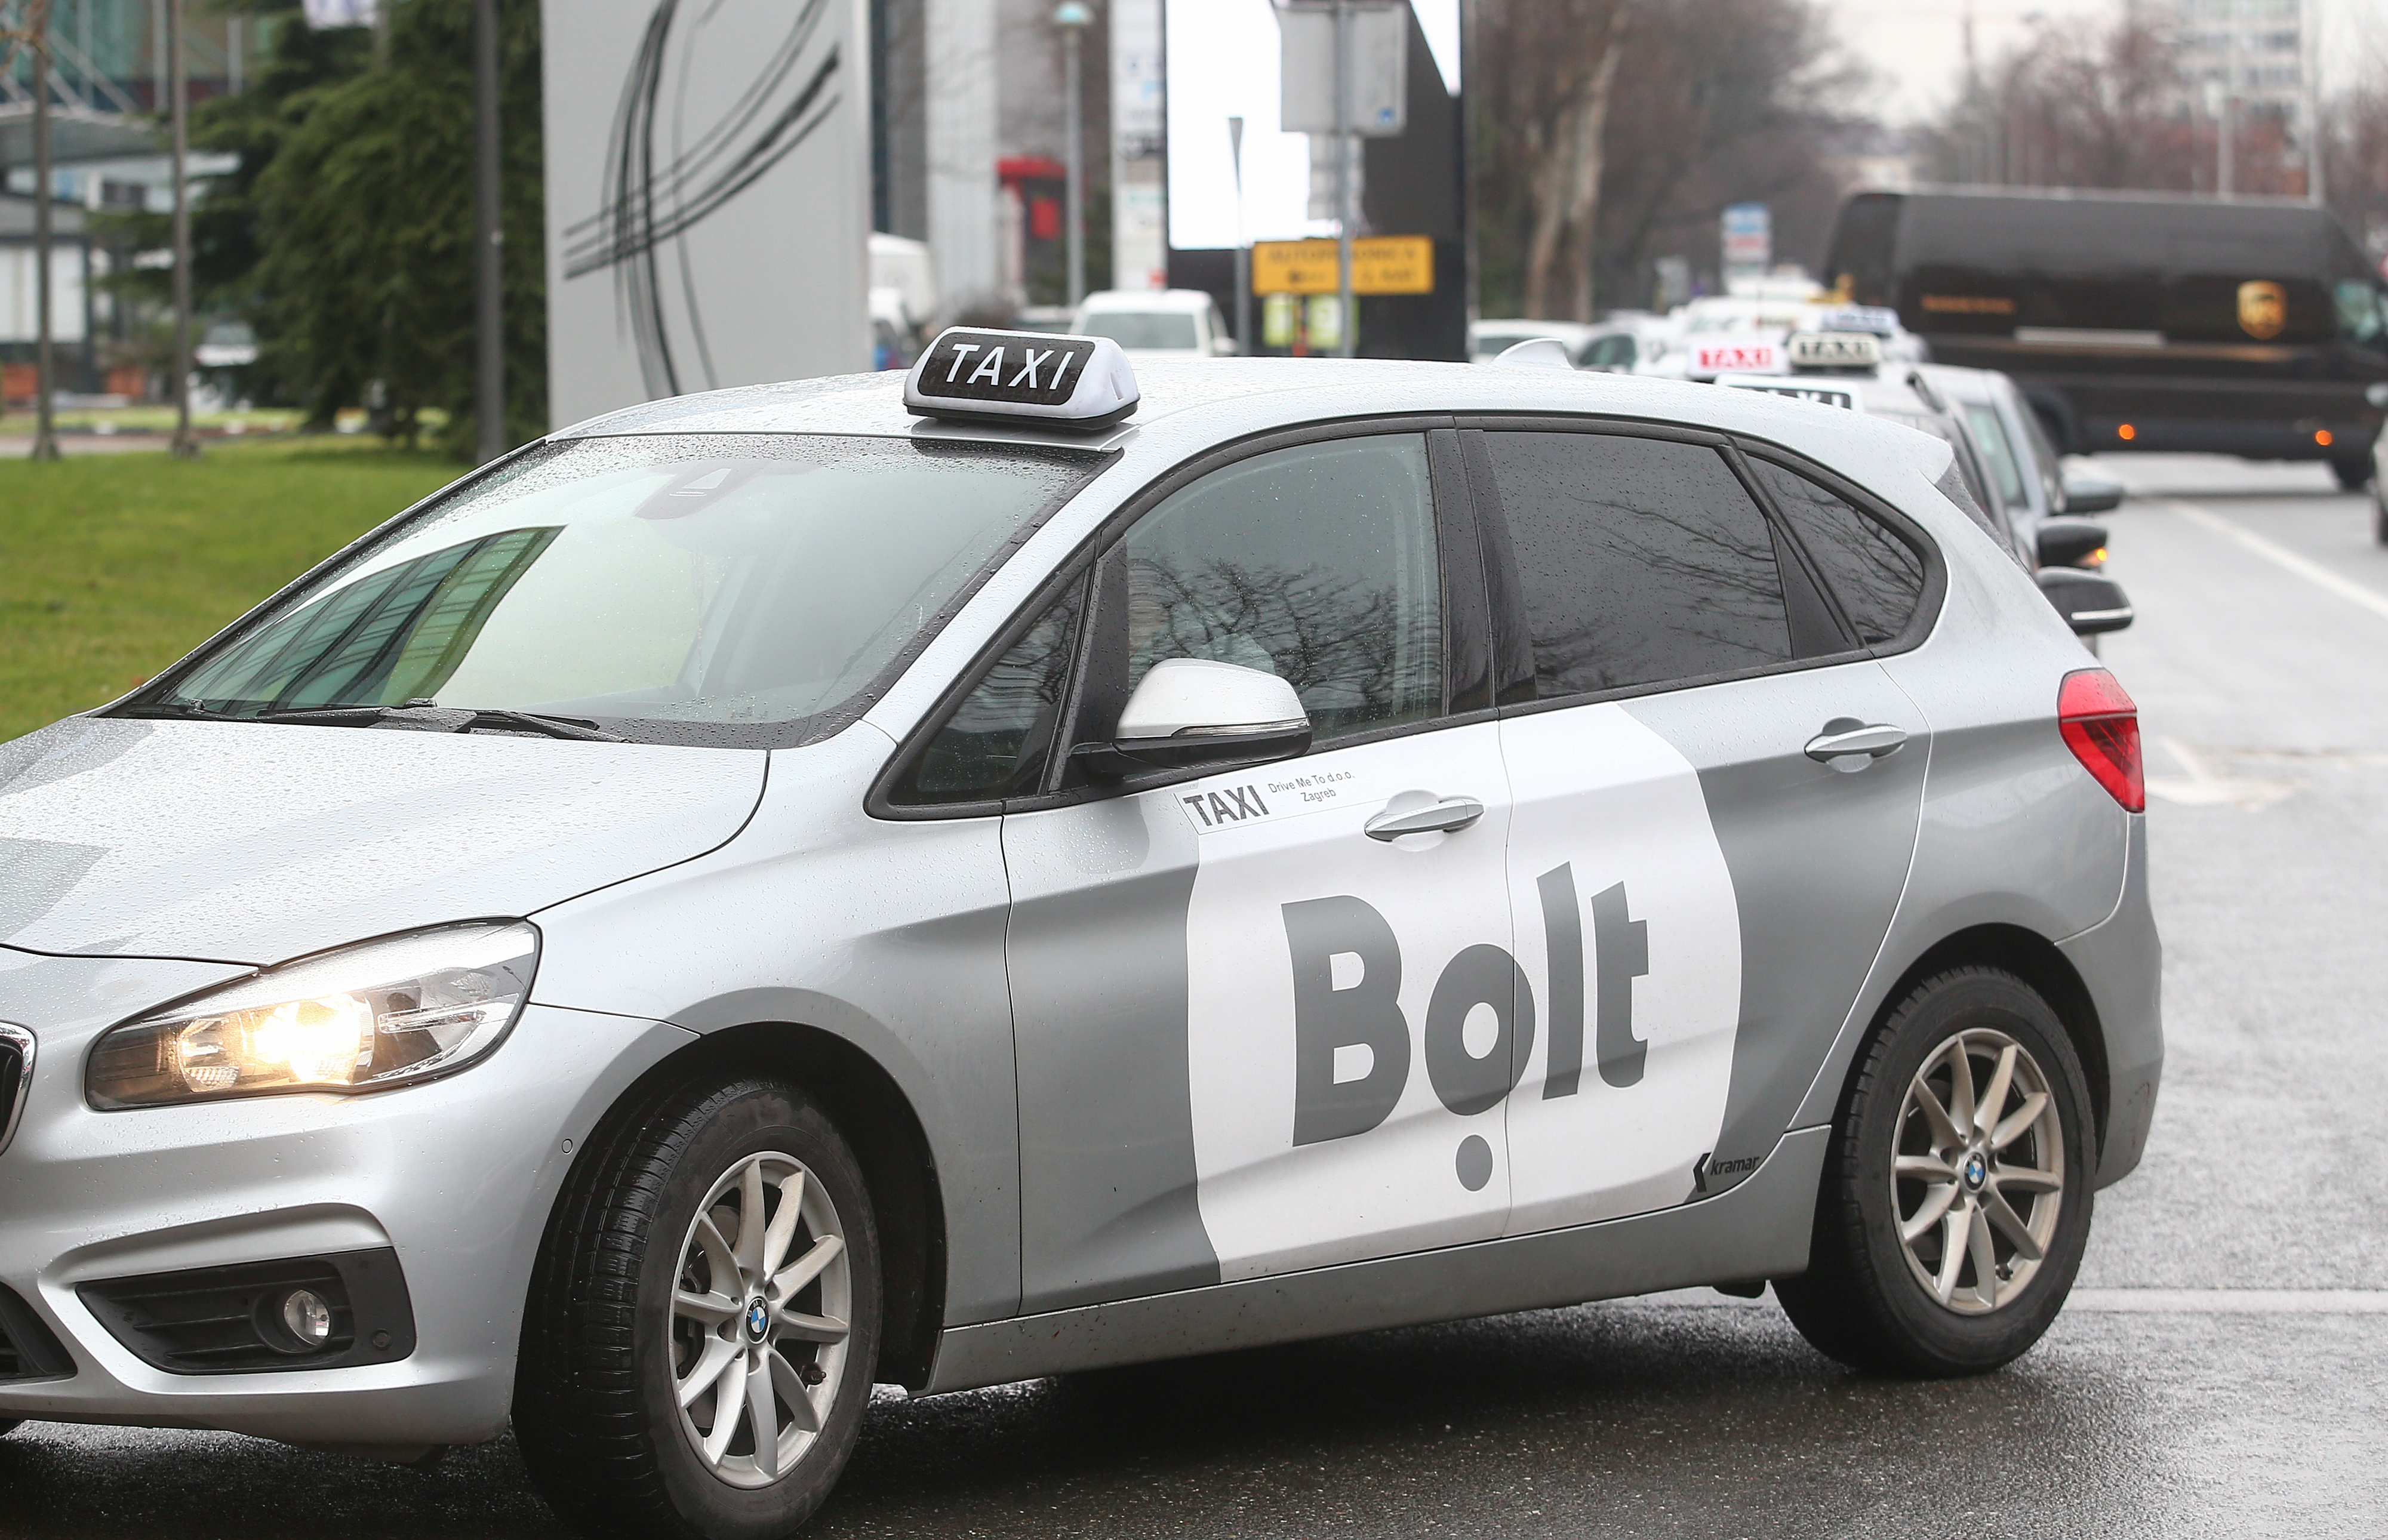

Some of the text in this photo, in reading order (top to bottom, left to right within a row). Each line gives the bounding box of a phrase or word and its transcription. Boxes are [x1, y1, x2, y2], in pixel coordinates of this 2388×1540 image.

[1698, 347, 1773, 368] TAXI
[1797, 338, 1872, 359] TAXI
[946, 344, 1075, 390] TAXI
[1267, 771, 1355, 793] Drive Me To d.o.o.
[1301, 787, 1336, 802] Zagreb
[1183, 785, 1270, 826] TAXI
[1281, 860, 1649, 1191] Bolt
[1710, 1156, 1760, 1175] kramar
